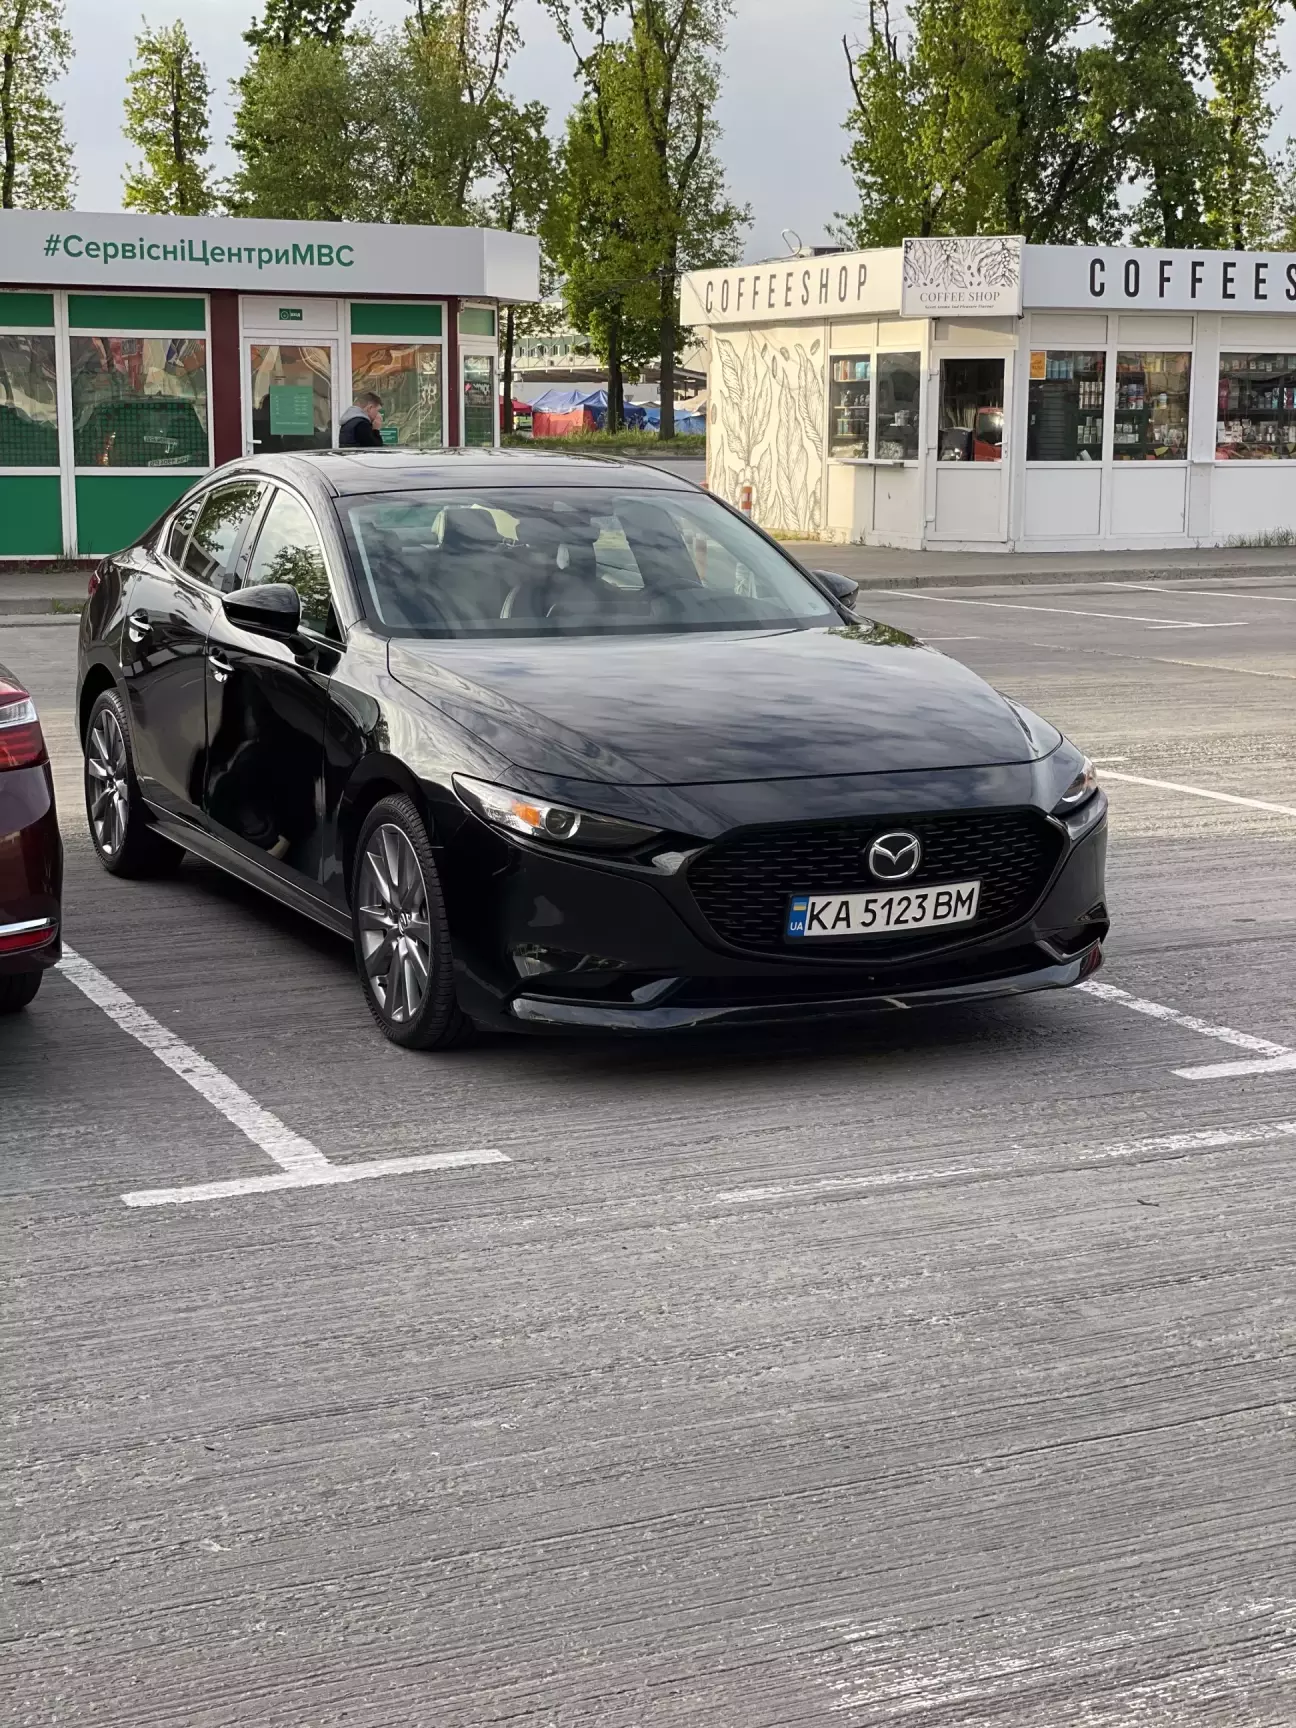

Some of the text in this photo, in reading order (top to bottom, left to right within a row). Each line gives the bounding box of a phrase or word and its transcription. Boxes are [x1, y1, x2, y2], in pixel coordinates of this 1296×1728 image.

[43, 234, 355, 269] #СервісніЦентриМВС
[705, 263, 868, 314] COFFEESHOP
[919, 291, 1001, 303] COFFEE SHOP
[1089, 257, 1296, 301] COFFEES
[790, 887, 976, 931] UA KA 5123 BM
